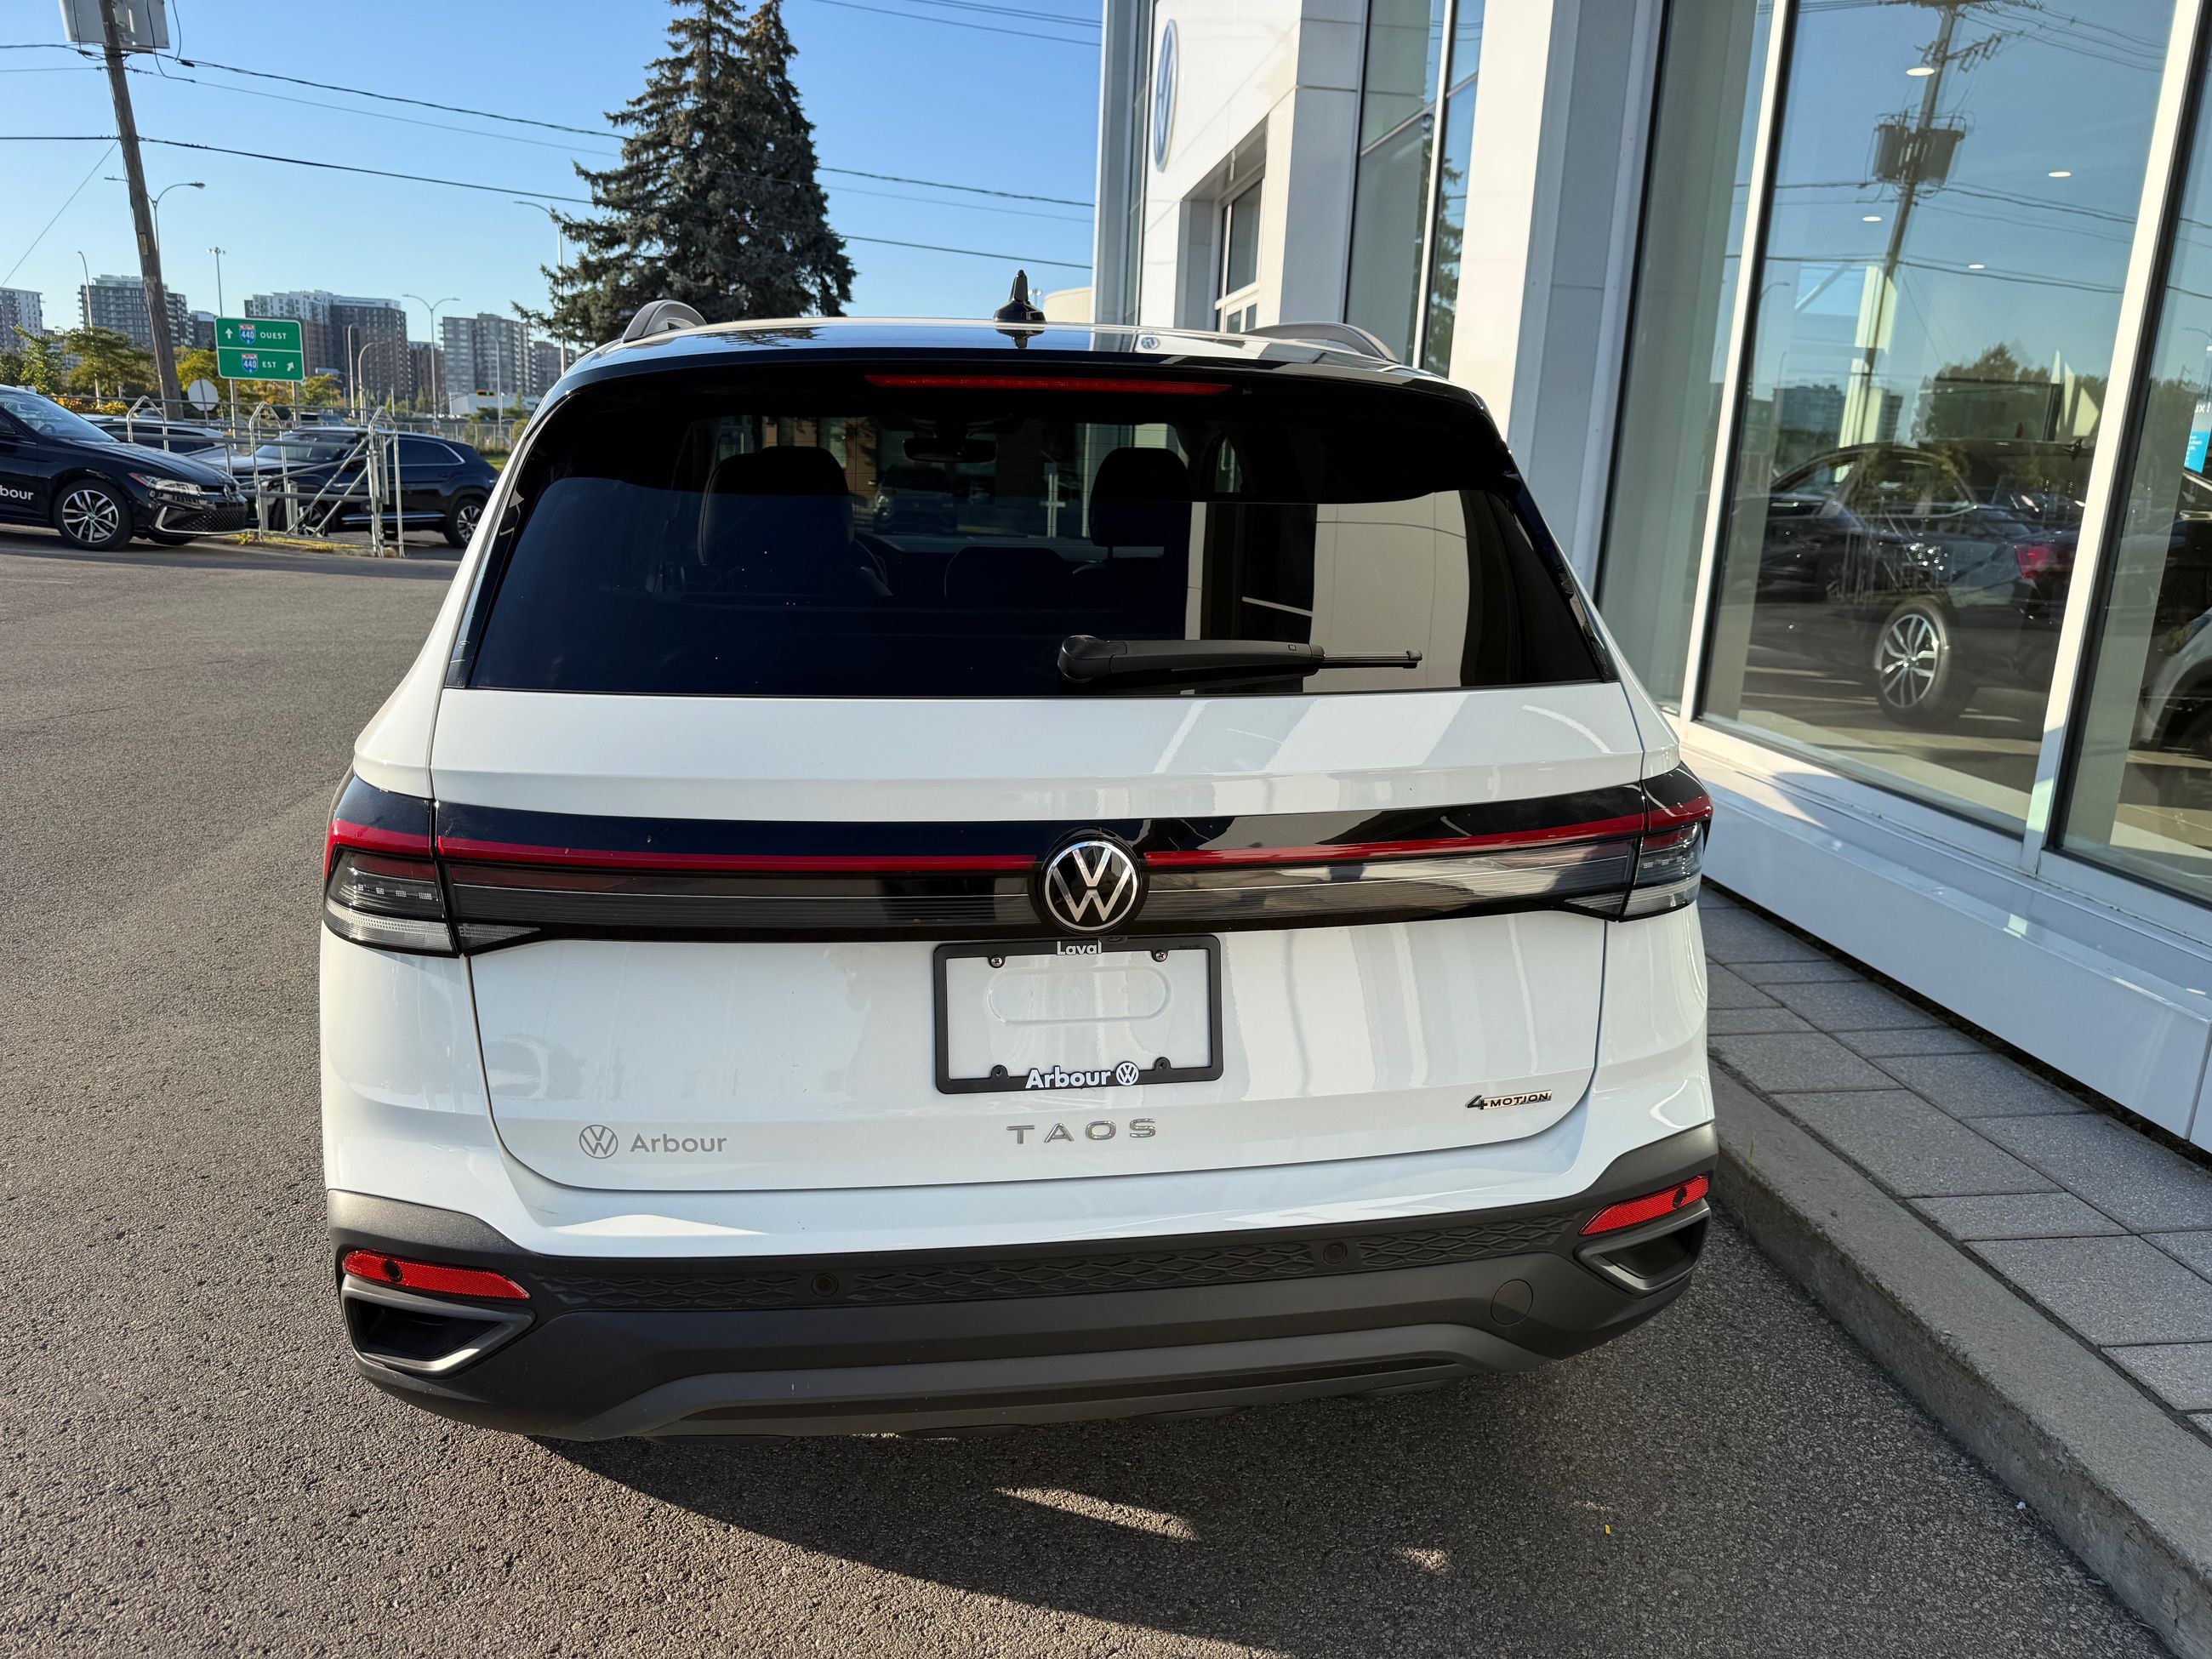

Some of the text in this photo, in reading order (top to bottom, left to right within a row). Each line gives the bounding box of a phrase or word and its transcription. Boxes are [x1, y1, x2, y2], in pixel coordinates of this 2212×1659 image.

[241, 330, 287, 339] 440 OUEST
[243, 360, 257, 368] 440
[1056, 939, 1103, 955] Laval
[1024, 1066, 1111, 1089] Arbour
[1465, 1092, 1550, 1110] 4MOTION
[1006, 1118, 1157, 1144] TAOS
[630, 1133, 727, 1153] Arbour
